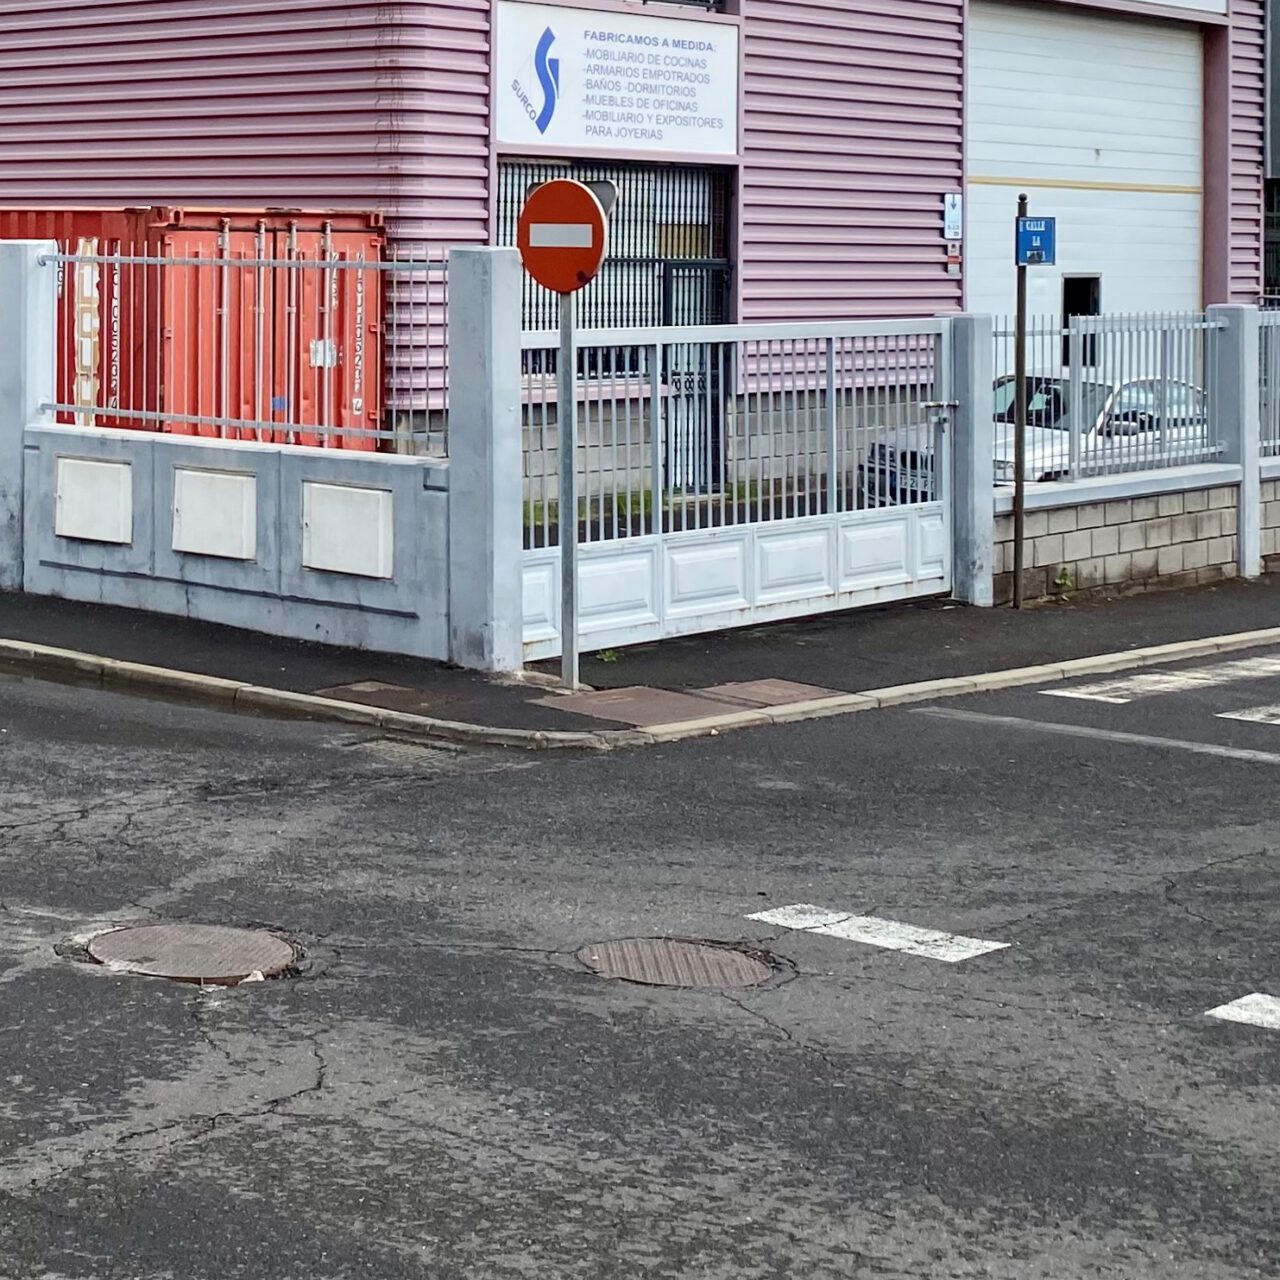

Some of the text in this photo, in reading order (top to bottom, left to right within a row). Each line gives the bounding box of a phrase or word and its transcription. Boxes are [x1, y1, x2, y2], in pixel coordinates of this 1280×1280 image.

[584, 30, 659, 47] FABRICAMOS
[661, 38, 669, 47] A
[648, 54, 661, 65] DE
[664, 55, 707, 69] COCINAS
[642, 69, 711, 84] EMPOTRADOS
[510, 79, 537, 120] SURCO
[636, 98, 649, 109] DE
[653, 99, 699, 112] OFICINAS
[647, 114, 654, 124] Y
[656, 115, 724, 129] EXPOSITORES
[585, 125, 664, 141] PARA JOYERIAS
